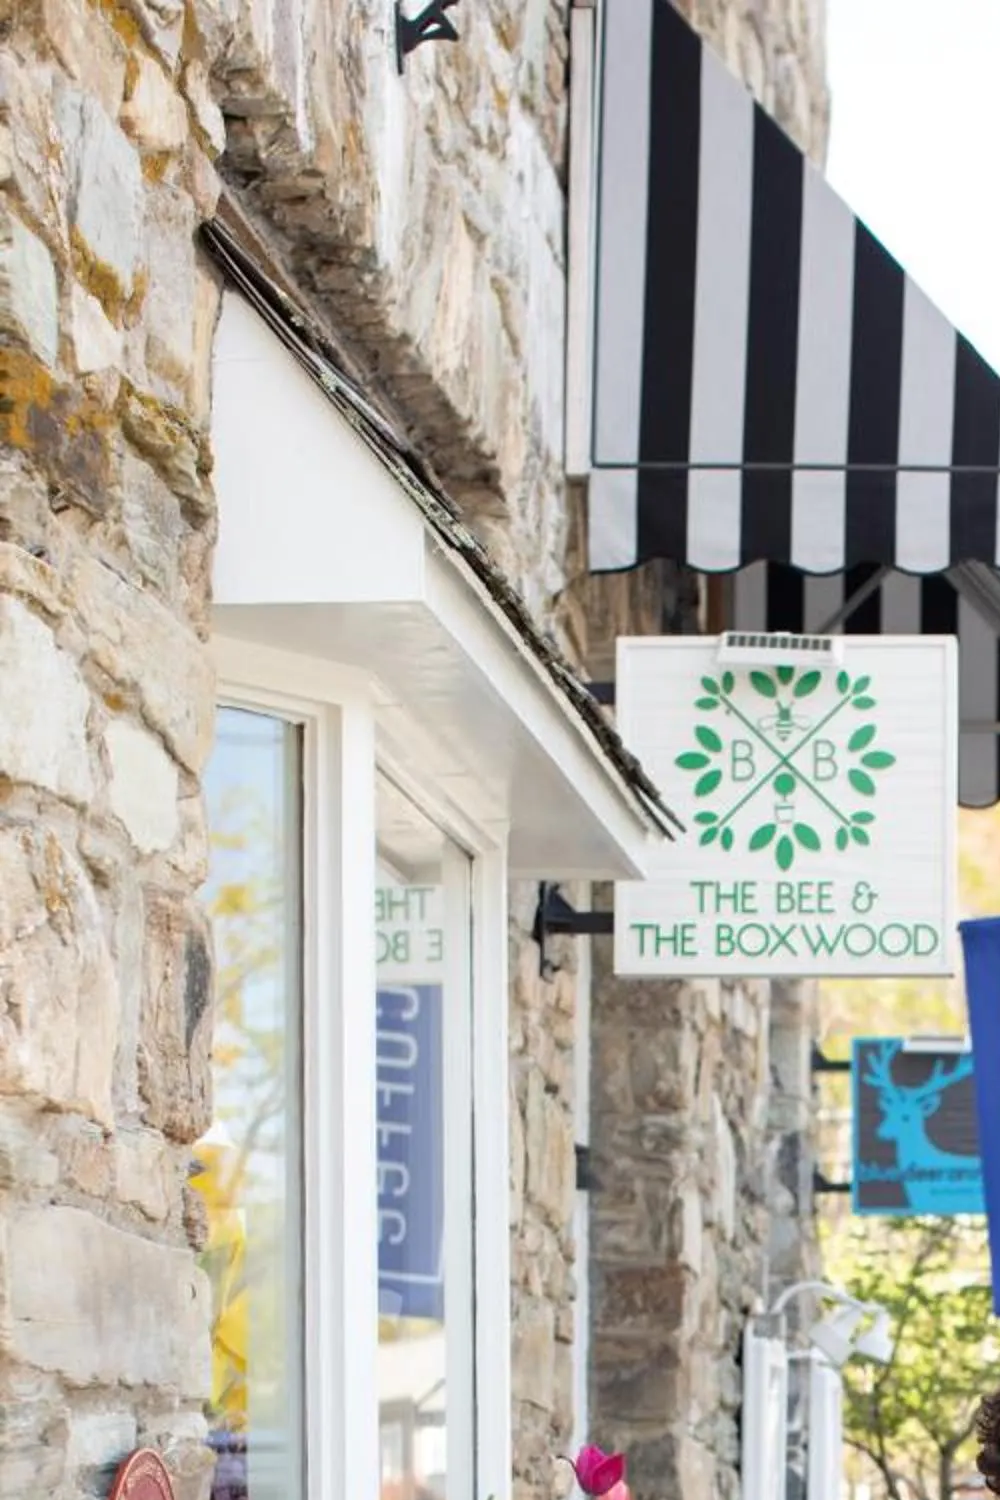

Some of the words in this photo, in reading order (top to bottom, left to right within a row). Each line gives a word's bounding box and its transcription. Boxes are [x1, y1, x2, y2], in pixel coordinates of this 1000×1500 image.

[731, 739, 756, 782] B
[813, 739, 838, 782] B
[690, 881, 758, 914] THE
[776, 881, 835, 914] BEE
[851, 880, 879, 914] &
[629, 923, 697, 957] THE
[716, 923, 940, 957] BOXWOOD
